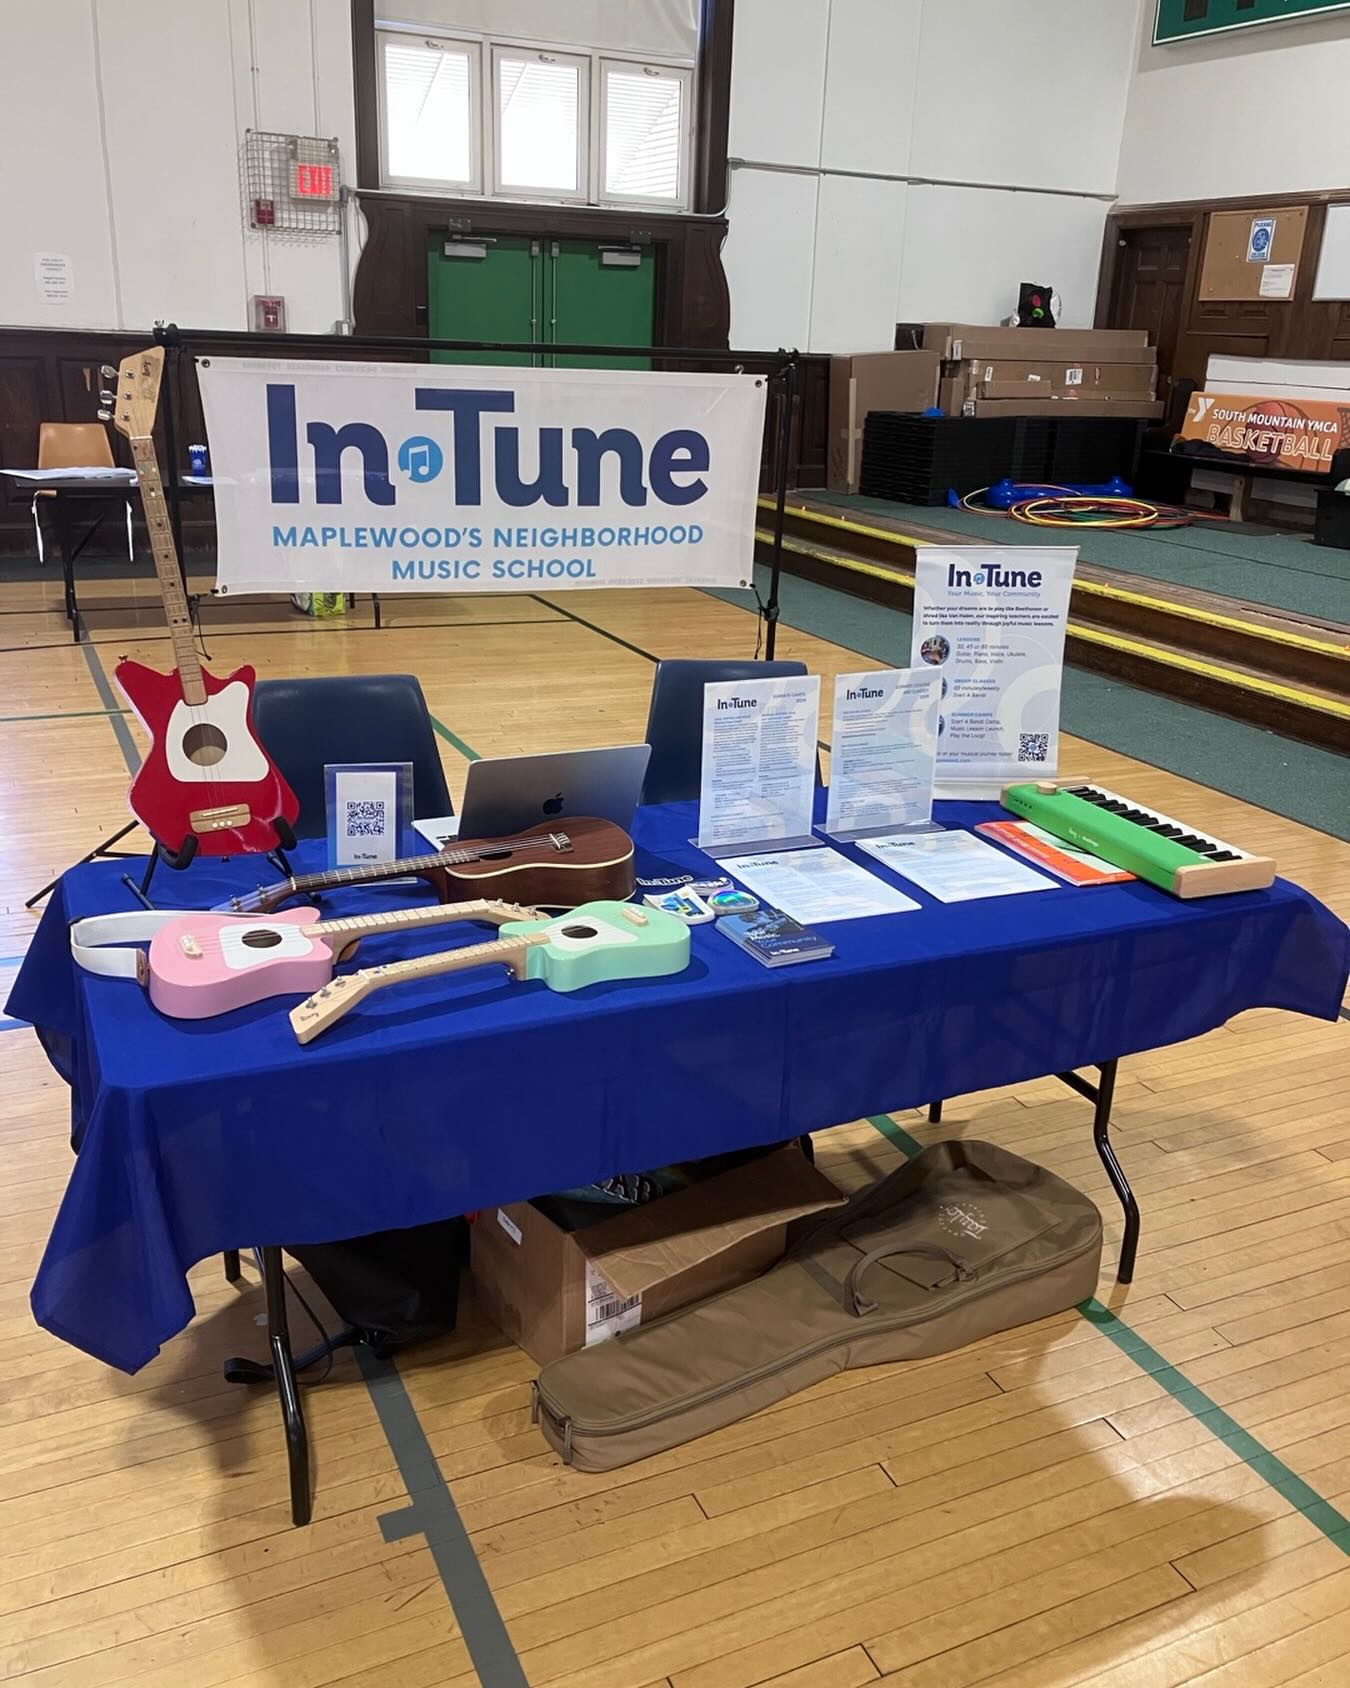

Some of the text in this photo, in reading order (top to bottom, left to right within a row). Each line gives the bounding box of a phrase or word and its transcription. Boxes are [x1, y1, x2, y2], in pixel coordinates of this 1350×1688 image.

[298, 165, 333, 195] EXIT
[1212, 408, 1338, 433] SOUTH MOUNTAIN YMCA
[1206, 424, 1333, 461] BASKETBALL
[272, 524, 704, 548] MAPLEWOOD'S NEIGHBORHOOD
[392, 558, 596, 580] MUSIC SCHOOL
[1002, 590, 1040, 598] Community
[760, 936, 817, 948] Community
